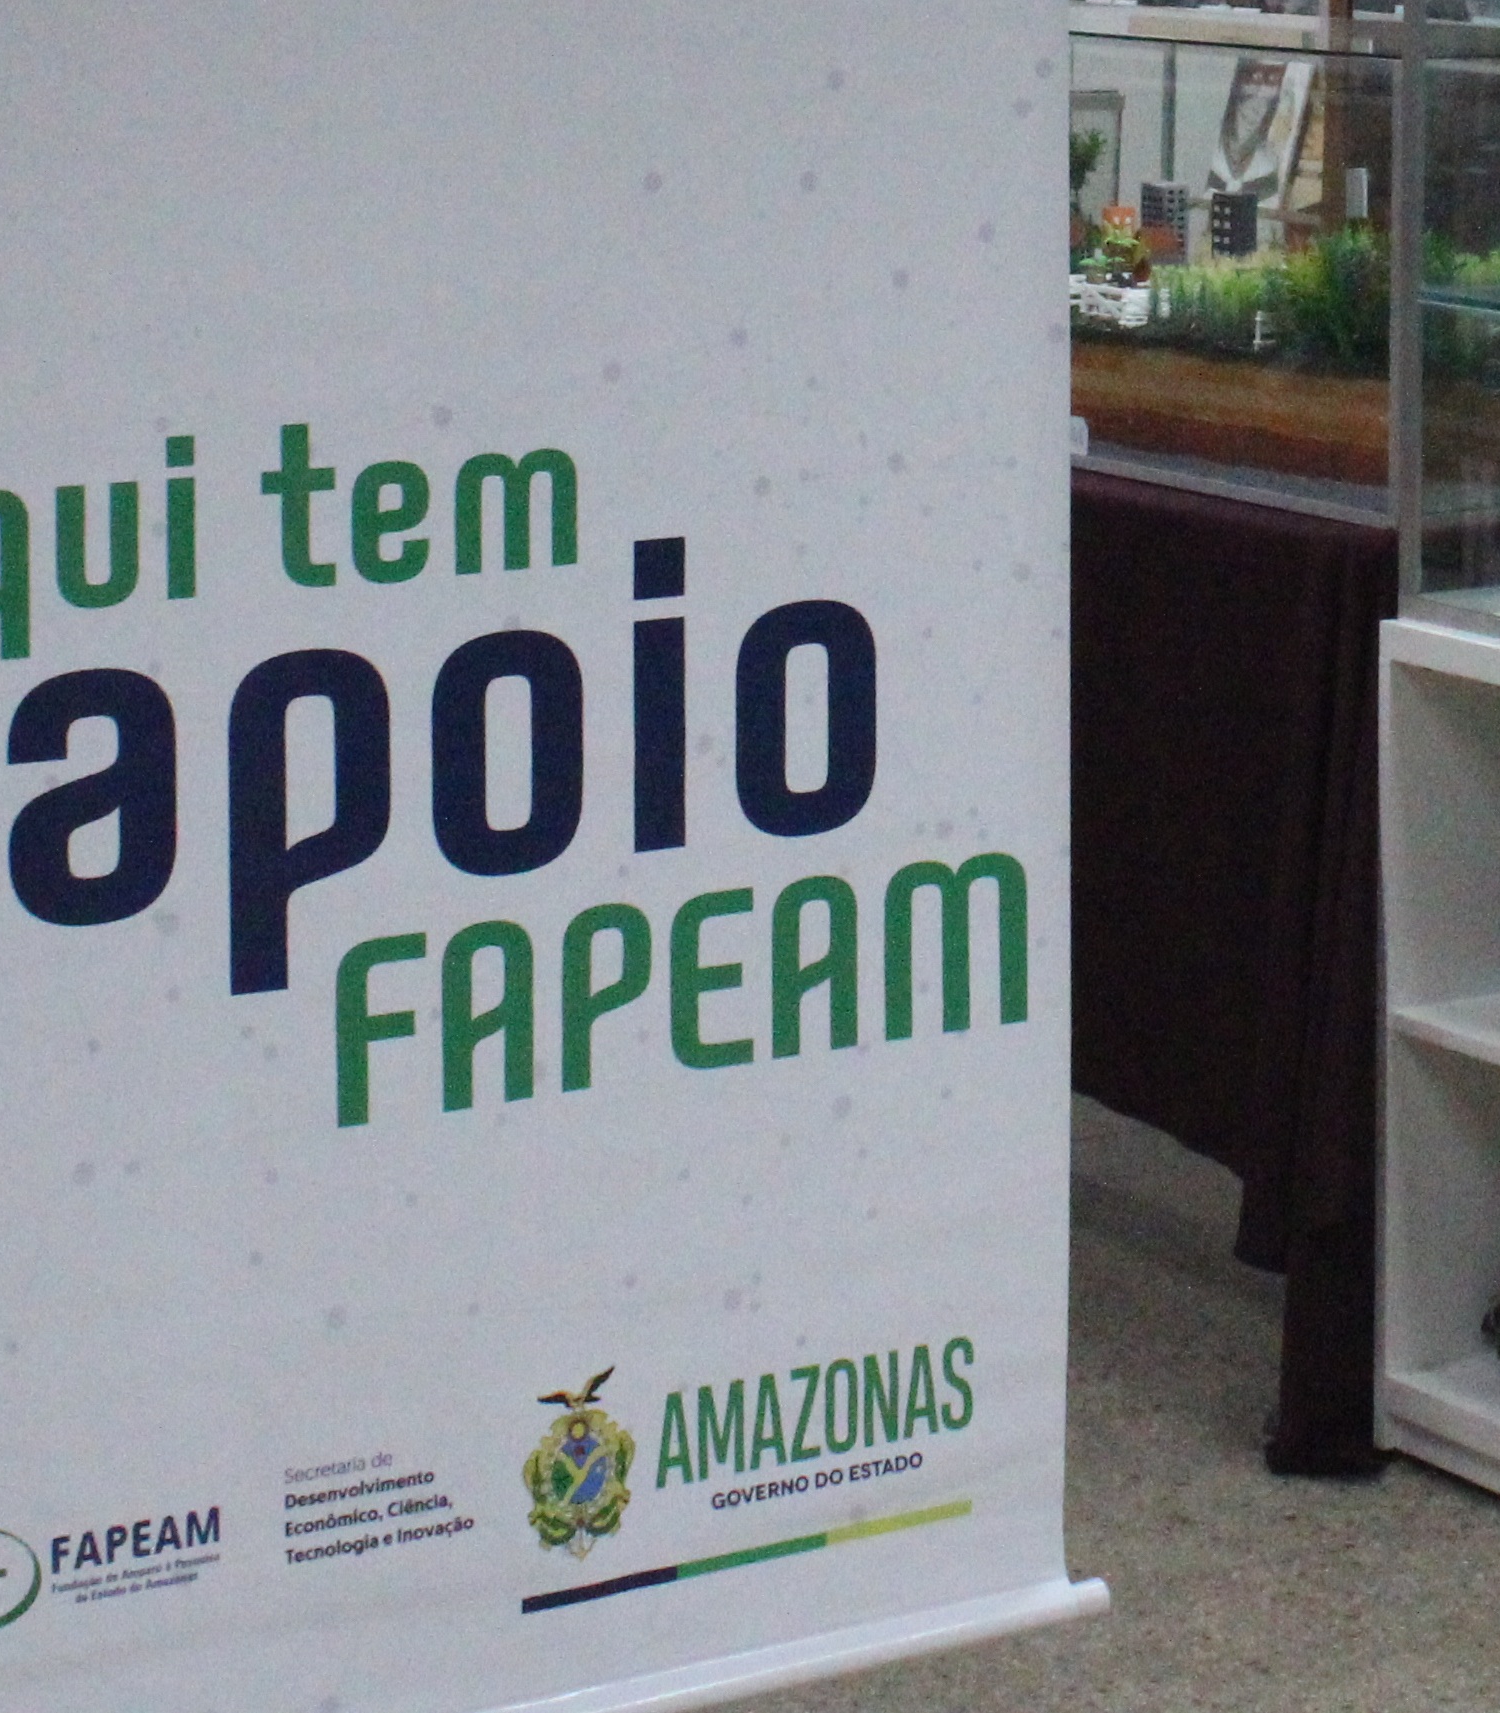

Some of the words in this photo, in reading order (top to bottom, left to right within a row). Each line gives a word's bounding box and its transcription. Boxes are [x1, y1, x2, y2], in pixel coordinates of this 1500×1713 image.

[260, 423, 579, 588] tem
[6, 536, 878, 996] apoio
[335, 851, 1029, 1128] FAPEAM
[656, 1336, 975, 1489] AMAZONAS
[284, 1455, 366, 1485] Secretaria
[370, 1451, 393, 1468] de
[284, 1470, 435, 1510] Desenvolvimento
[711, 1475, 809, 1510] GOVERNO
[815, 1469, 844, 1490] DO
[849, 1452, 923, 1482] ESTADO
[51, 1506, 221, 1575] FAPEAM
[284, 1507, 384, 1538] Econômico,
[387, 1494, 453, 1518] Ciência,
[285, 1534, 380, 1565] Tecnologia
[382, 1532, 393, 1546] e
[397, 1515, 475, 1543] Inovação
[51, 1576, 103, 1594] Fundação
[122, 1565, 162, 1580] Amparo
[91, 1586, 127, 1601] Estado
[145, 1572, 198, 1590] Amazonas
